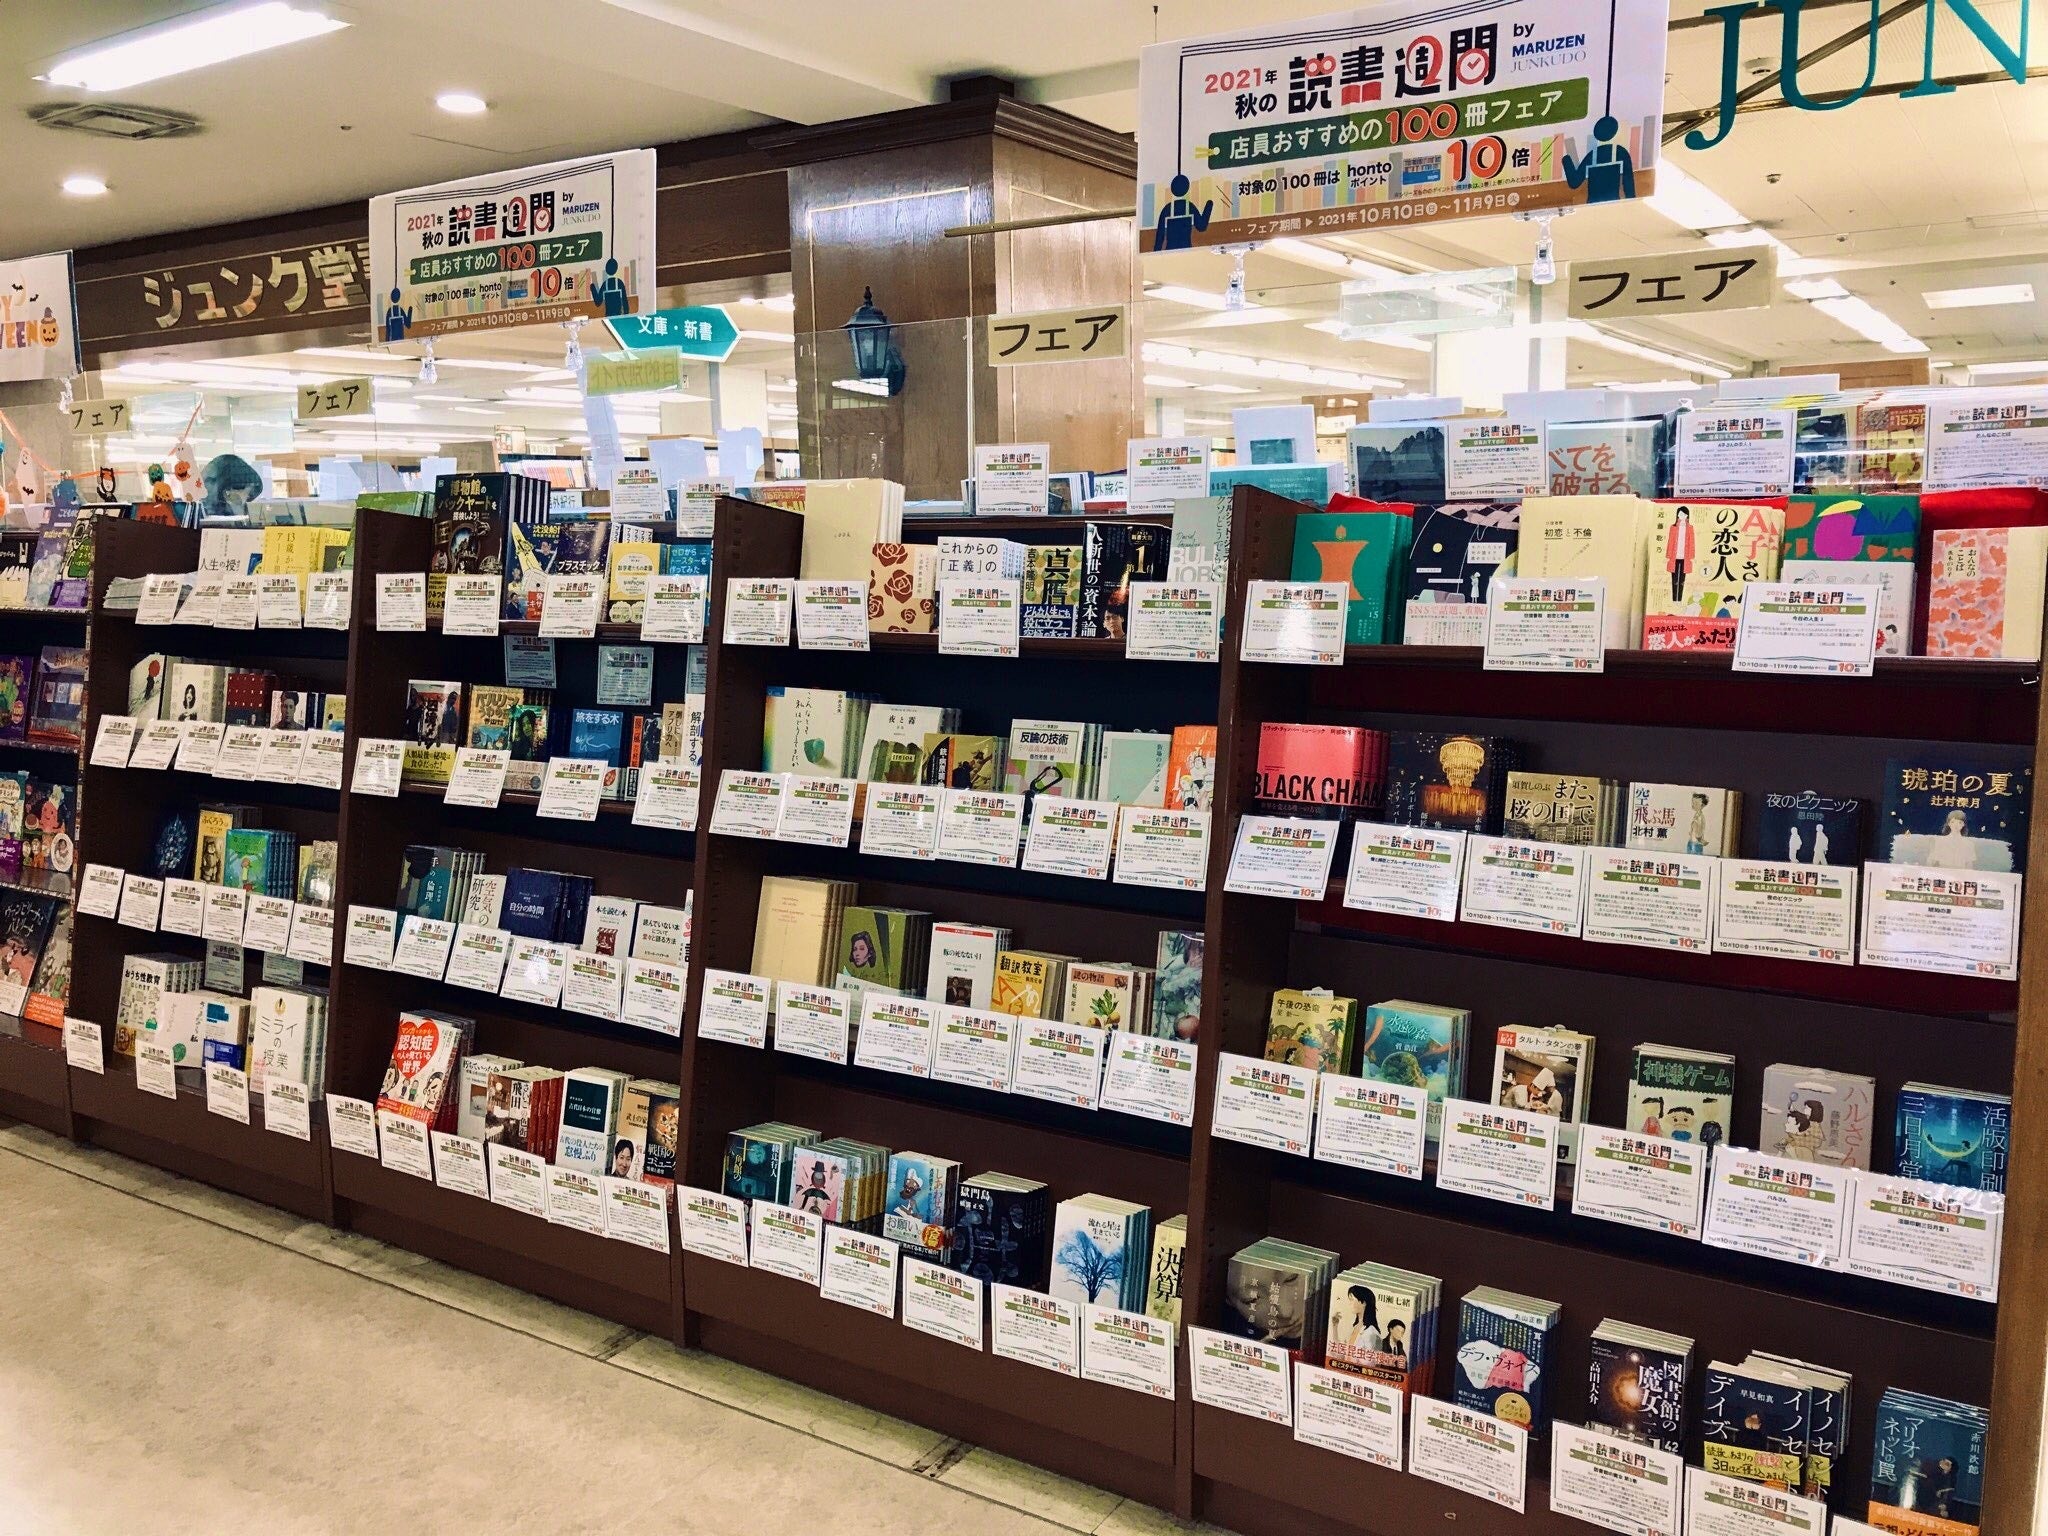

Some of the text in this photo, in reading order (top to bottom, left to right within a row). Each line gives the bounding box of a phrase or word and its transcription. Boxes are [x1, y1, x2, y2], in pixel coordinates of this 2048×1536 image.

[1512, 22, 1535, 39] by
[1512, 34, 1586, 58] MARUZEN
[1288, 22, 1498, 115] 読書週間
[1509, 50, 1587, 73] JUNKUDO
[1204, 66, 1278, 95] 2021年
[1234, 93, 1278, 120] 秋の
[1229, 89, 1563, 160] 店員おすすめの100冊フェア
[1347, 160, 1392, 179] honto
[1350, 175, 1387, 188] ポイント
[562, 191, 574, 203] by
[449, 191, 554, 247] 読書週間
[561, 213, 600, 226] JUNKUDO
[562, 202, 600, 215] MARUZEN
[407, 213, 443, 231] 2021年
[422, 231, 443, 249] 秋の
[420, 238, 589, 279] 店員おすすめの100冊フェア
[479, 282, 502, 293] honto
[1578, 258, 1757, 311] フェア
[481, 292, 500, 300] ポイント
[638, 316, 712, 341] 文庫・新書
[994, 314, 1118, 357] フェア
[306, 385, 360, 413] フェア
[72, 404, 124, 429] フェア
[941, 543, 998, 555] これからの
[1709, 508, 1740, 582] の恋人
[939, 559, 997, 573] 「正義」の
[1025, 548, 1037, 592] 吉本隆明
[576, 712, 619, 725] 旅をする木
[888, 715, 916, 725] 夜と霧
[1020, 732, 1069, 745] 反論の技術
[1555, 779, 1595, 801] また、
[1902, 768, 2013, 796] 琥珀の夏
[1510, 799, 1595, 826] 桜の国で
[1766, 793, 1859, 813] 夜のピクニック
[1931, 796, 1981, 809] 辻村深月
[1634, 807, 1675, 827] 飛ぶ馬
[509, 902, 545, 916] 自分の時間
[596, 906, 627, 917] 本を読む本
[643, 919, 680, 931] 読んでいない本
[1000, 955, 1043, 976] 翻訳教室
[1277, 998, 1320, 1013] 午後の恐竜
[261, 1016, 299, 1038] ミライ
[274, 1037, 281, 1048] の
[398, 1035, 434, 1051] 認知症
[1518, 1036, 1582, 1051] タルト・タタンの夢
[264, 1049, 288, 1070] 授業
[402, 1061, 421, 1073] 世界
[1643, 1060, 1732, 1088] 神様ゲーム
[1843, 1086, 1869, 1168] ハルさん
[1900, 1095, 1926, 1180] 三日月堂
[1980, 1104, 2007, 1191] 活版印刷
[960, 1186, 990, 1201] 獄門島
[1156, 1246, 1179, 1304] 決算
[1328, 1340, 1407, 1369] 法医昆虫学捜査官
[1460, 1346, 1539, 1376] デフ・ヴォイス
[1589, 1361, 1600, 1405] 高田大介
[1638, 1365, 1663, 1415] 魔女
[1660, 1360, 1683, 1432] 図書館の
[1740, 1389, 1774, 1405] 早見和真
[1704, 1375, 1735, 1440] デイズ
[1902, 1417, 1924, 1459] マリオ
[1877, 1417, 1900, 1482] ネットの罠
[1968, 1432, 1982, 1476] 赤川次郎
